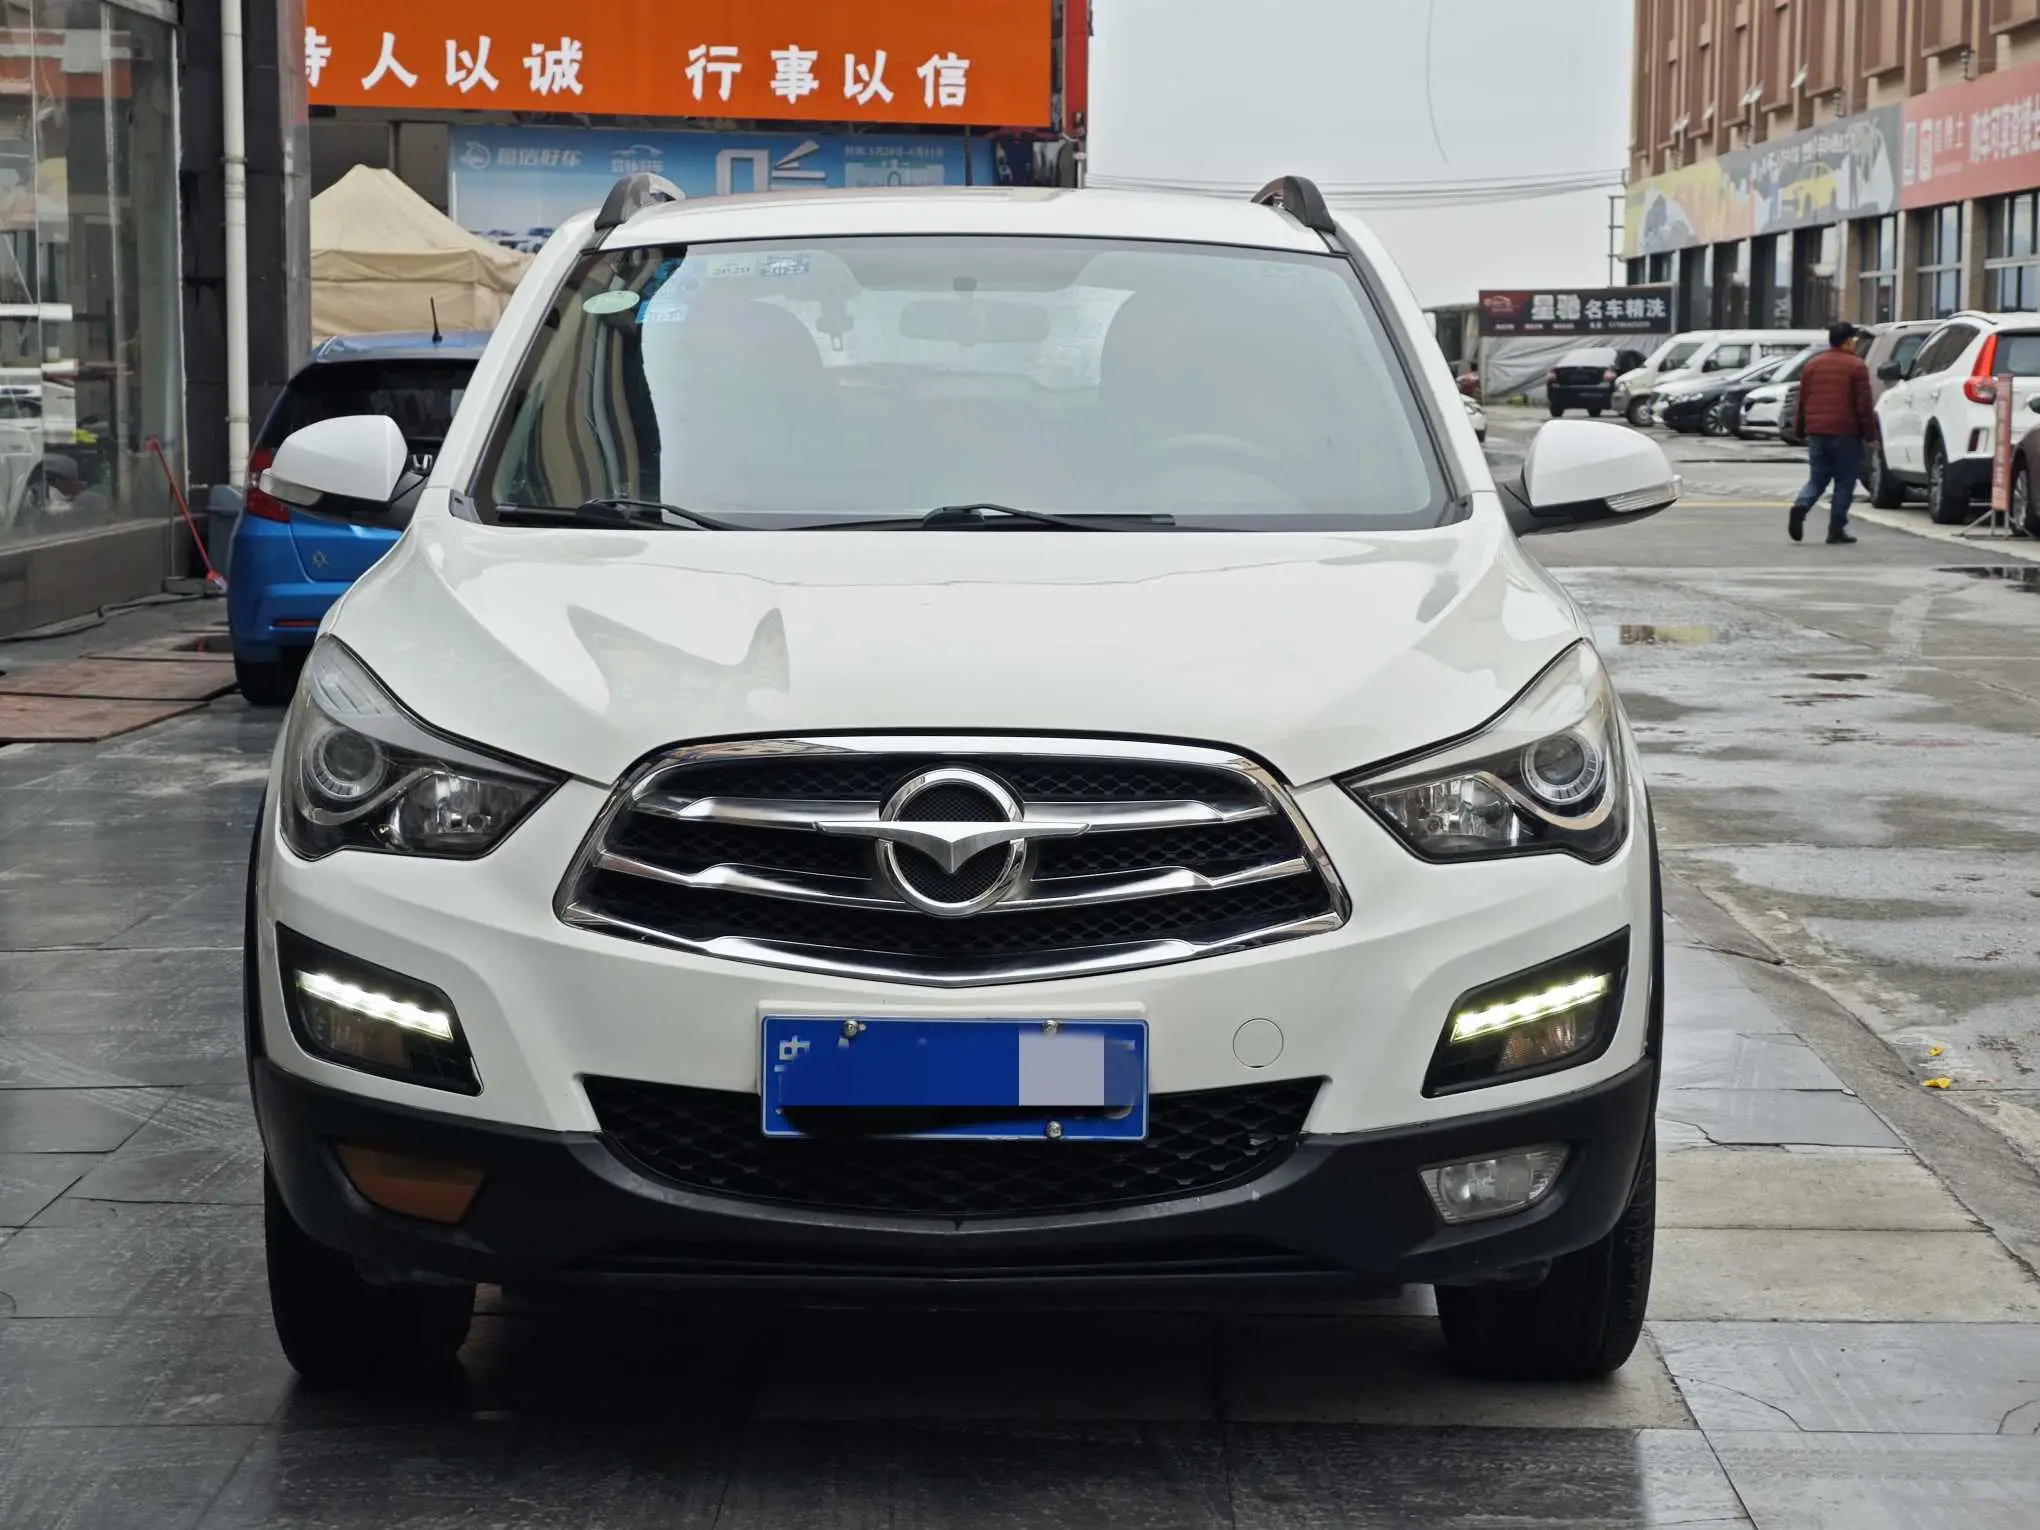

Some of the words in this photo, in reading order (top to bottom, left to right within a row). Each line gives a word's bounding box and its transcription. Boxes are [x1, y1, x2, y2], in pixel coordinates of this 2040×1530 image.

[685, 44, 971, 108] 行事以信
[1585, 297, 1666, 319] 名车精洗
